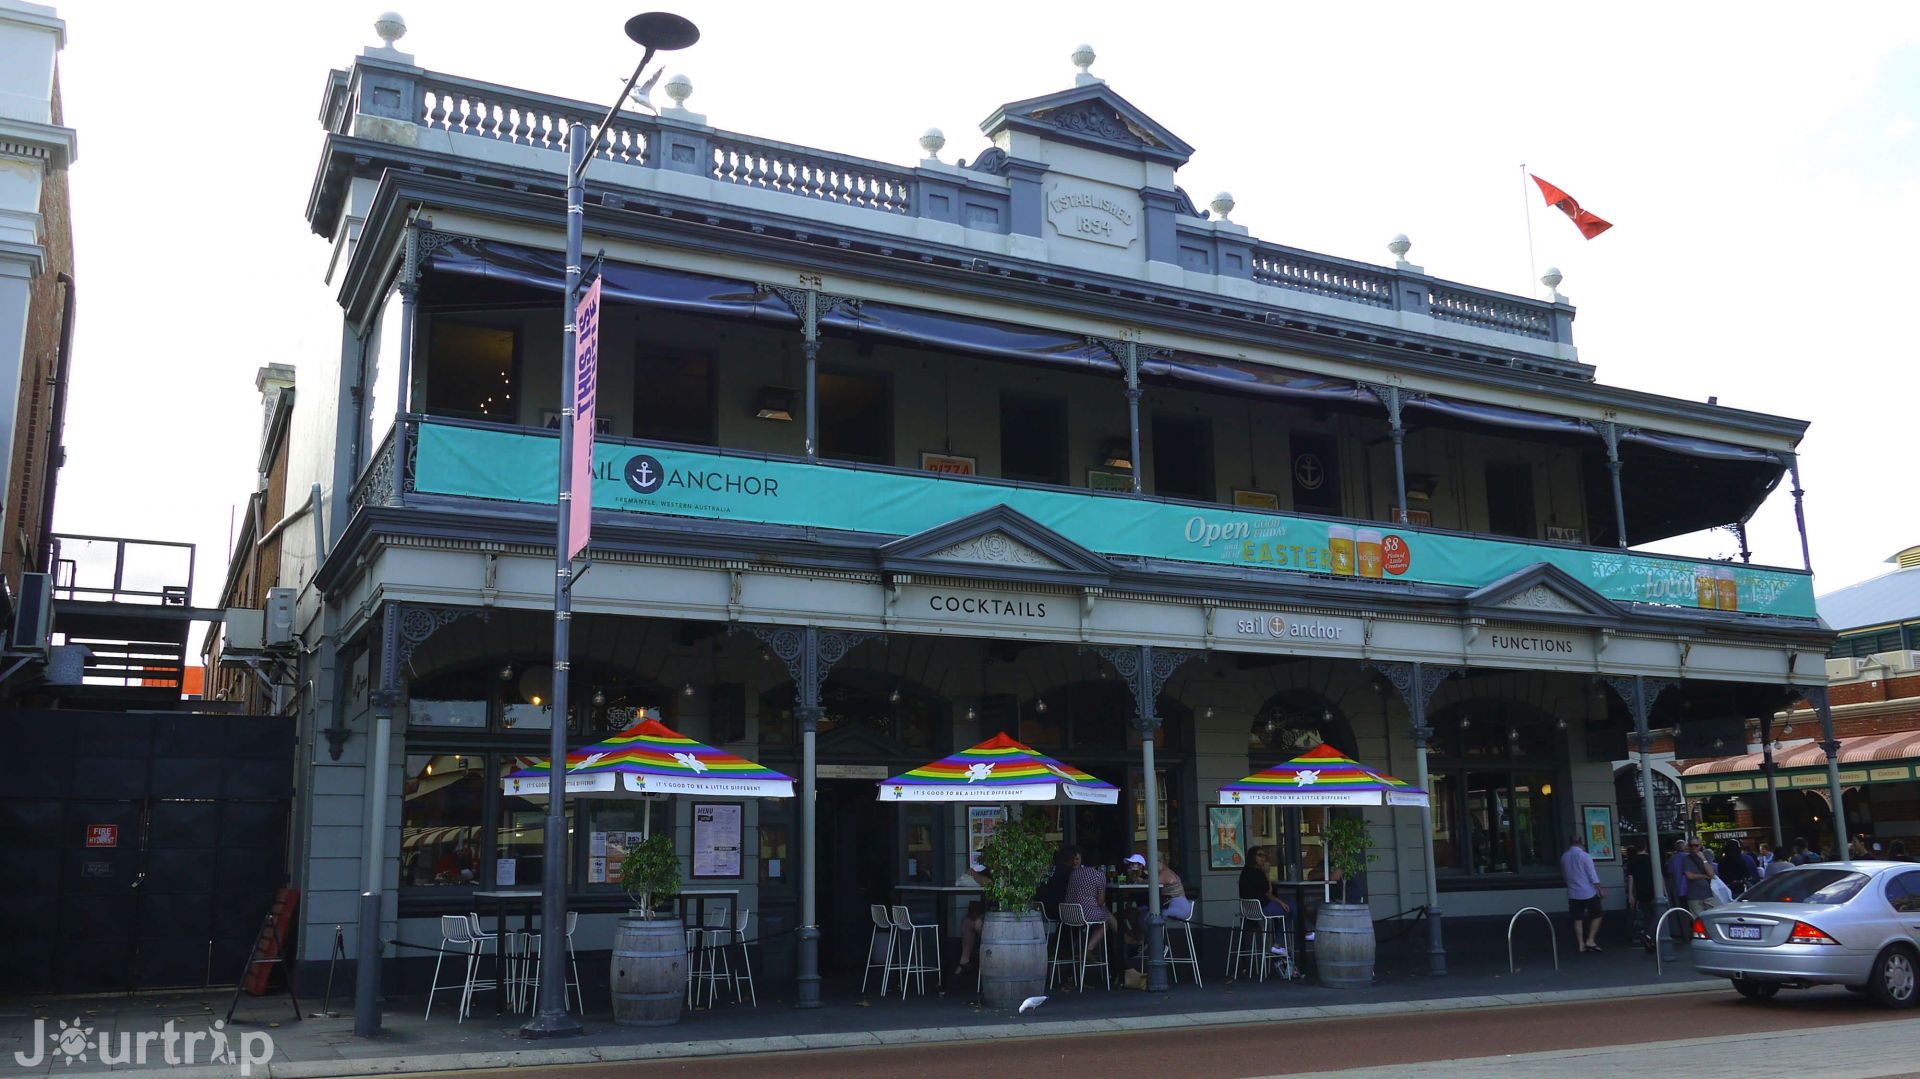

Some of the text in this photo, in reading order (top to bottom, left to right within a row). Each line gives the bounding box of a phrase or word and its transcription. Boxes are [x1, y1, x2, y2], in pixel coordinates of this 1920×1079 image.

[1050, 193, 1133, 226] ESTABLISHED
[1077, 216, 1112, 237] 1854
[577, 311, 592, 421] THIS IS
[667, 469, 779, 497] ANCHOR
[694, 505, 731, 513] AUSTRALIA
[1184, 516, 1250, 548] Open
[1253, 519, 1281, 529] GOOD
[1253, 527, 1287, 538] FRIDAY
[1384, 537, 1399, 553] $8
[1242, 540, 1333, 571] EASTER
[930, 595, 1046, 618] COCKTAILS
[1237, 616, 1342, 639] sail anchor
[1491, 635, 1573, 653] FUNCTIONS
[697, 807, 714, 815] MENU
[93, 827, 112, 835] FIRE
[1713, 831, 1748, 840] INFORMATION
